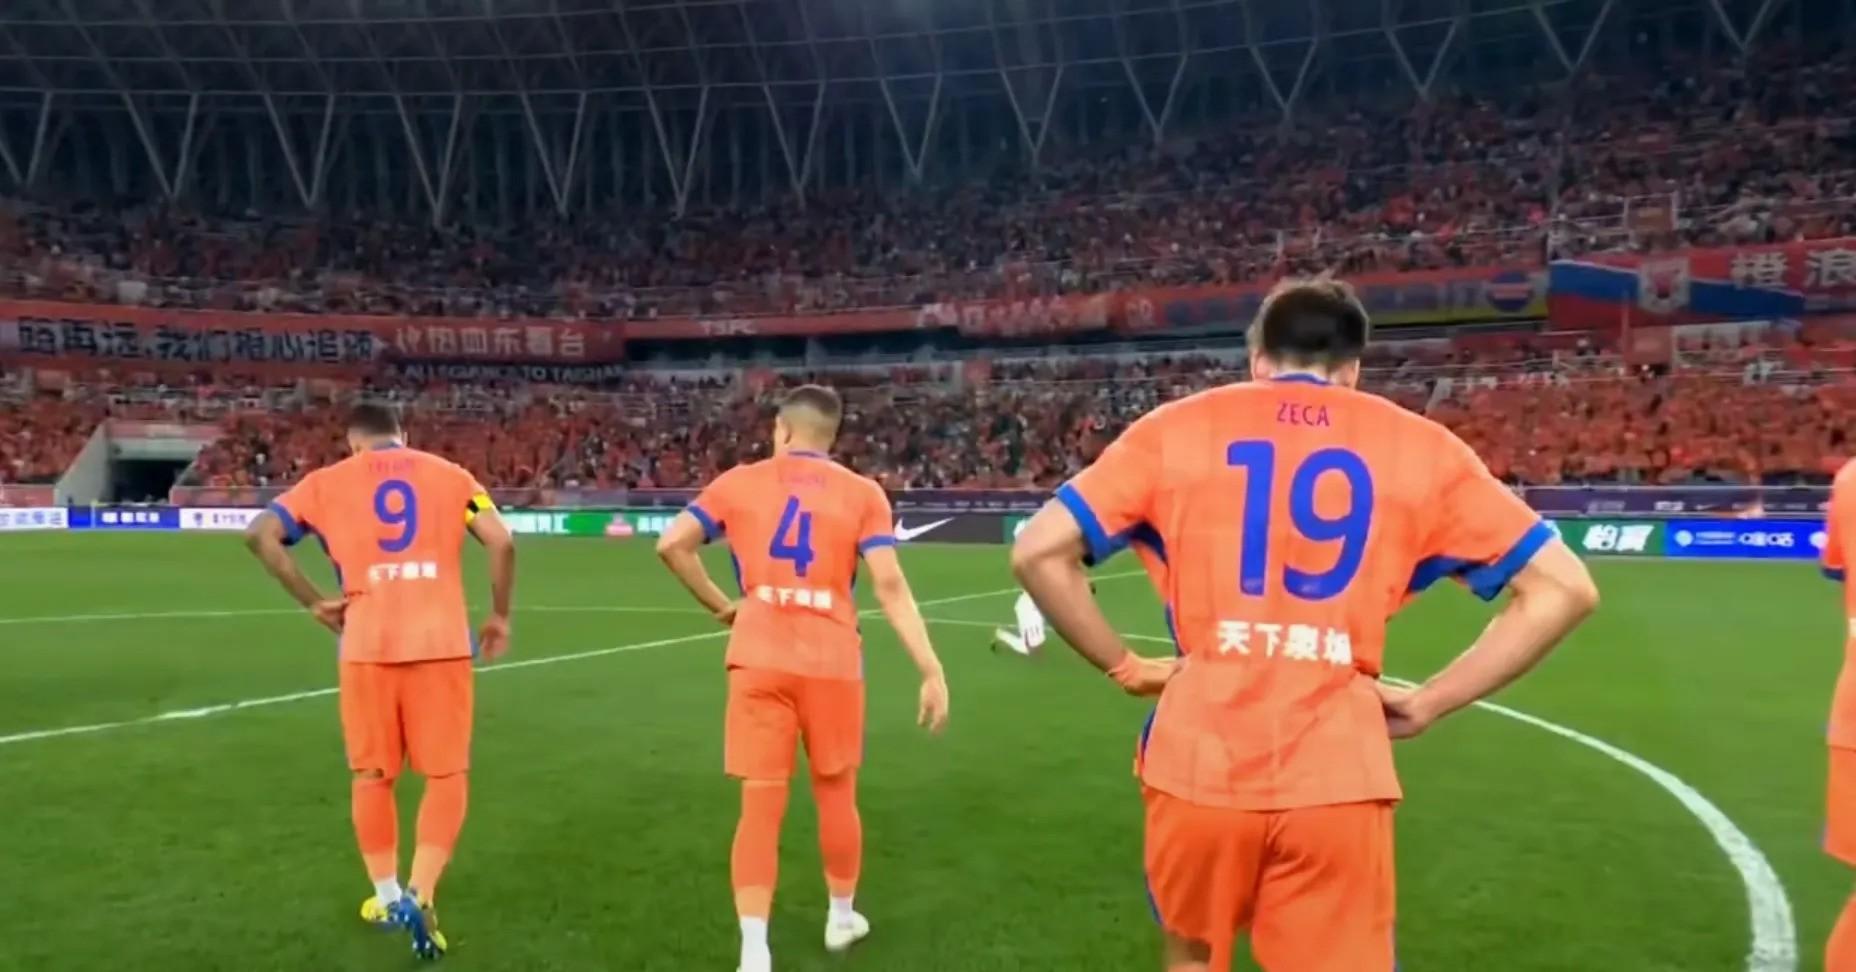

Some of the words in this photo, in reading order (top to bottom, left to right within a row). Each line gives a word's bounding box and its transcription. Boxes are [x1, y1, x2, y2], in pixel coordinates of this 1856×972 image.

[1276, 402, 1331, 427] ZECA
[373, 478, 418, 553] 9
[769, 495, 815, 578] 4
[1226, 440, 1375, 602] 19
